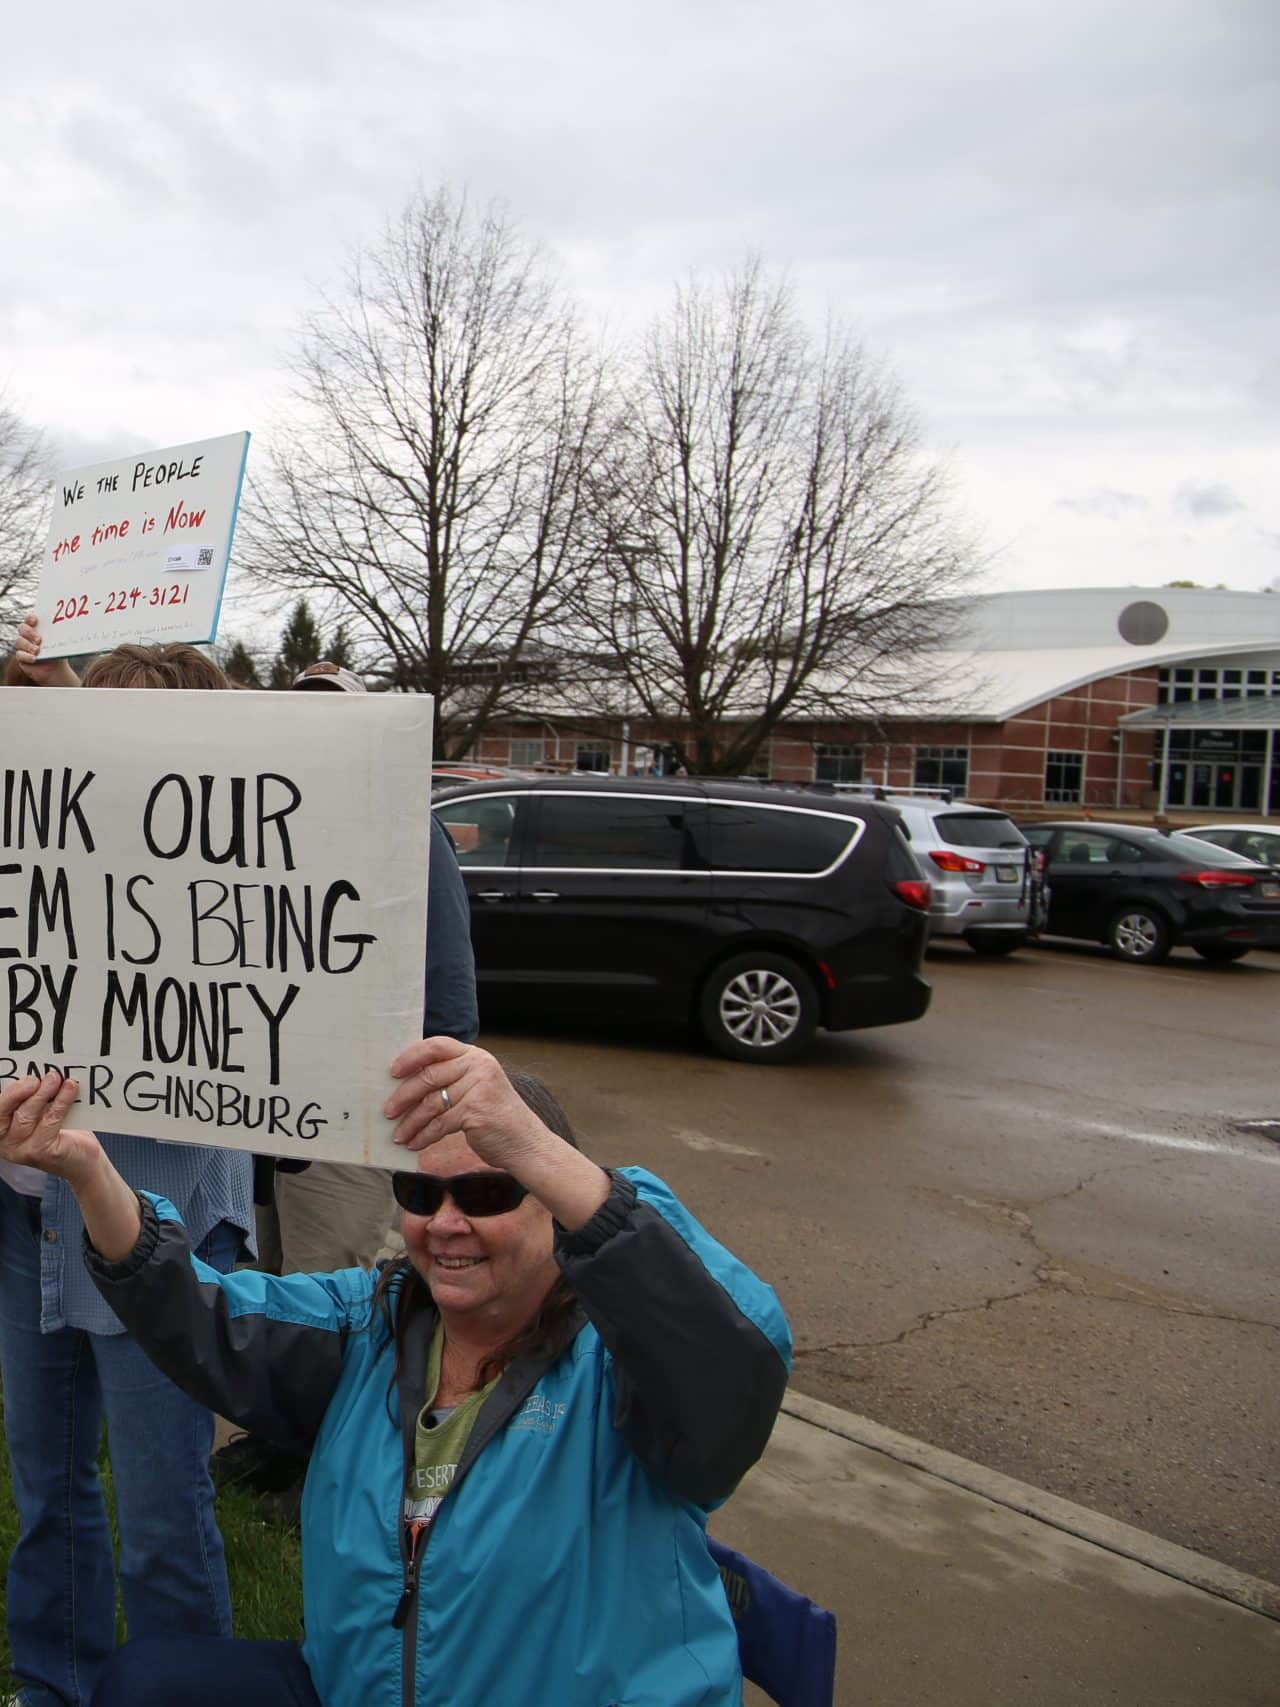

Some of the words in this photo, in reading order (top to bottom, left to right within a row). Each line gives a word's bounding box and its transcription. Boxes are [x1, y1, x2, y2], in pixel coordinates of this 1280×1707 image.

[97, 474, 119, 495] THE
[132, 456, 204, 492] PEOPLE
[53, 535, 80, 561] the
[91, 520, 129, 546] time
[142, 511, 155, 534] is
[52, 583, 190, 624] 202-224-3121
[143, 773, 302, 871] OUR
[105, 873, 161, 965] IS
[187, 879, 378, 974] BEING
[8, 963, 78, 1054] BY
[100, 970, 300, 1085] MONEY
[123, 1071, 329, 1140] GINSBURG
